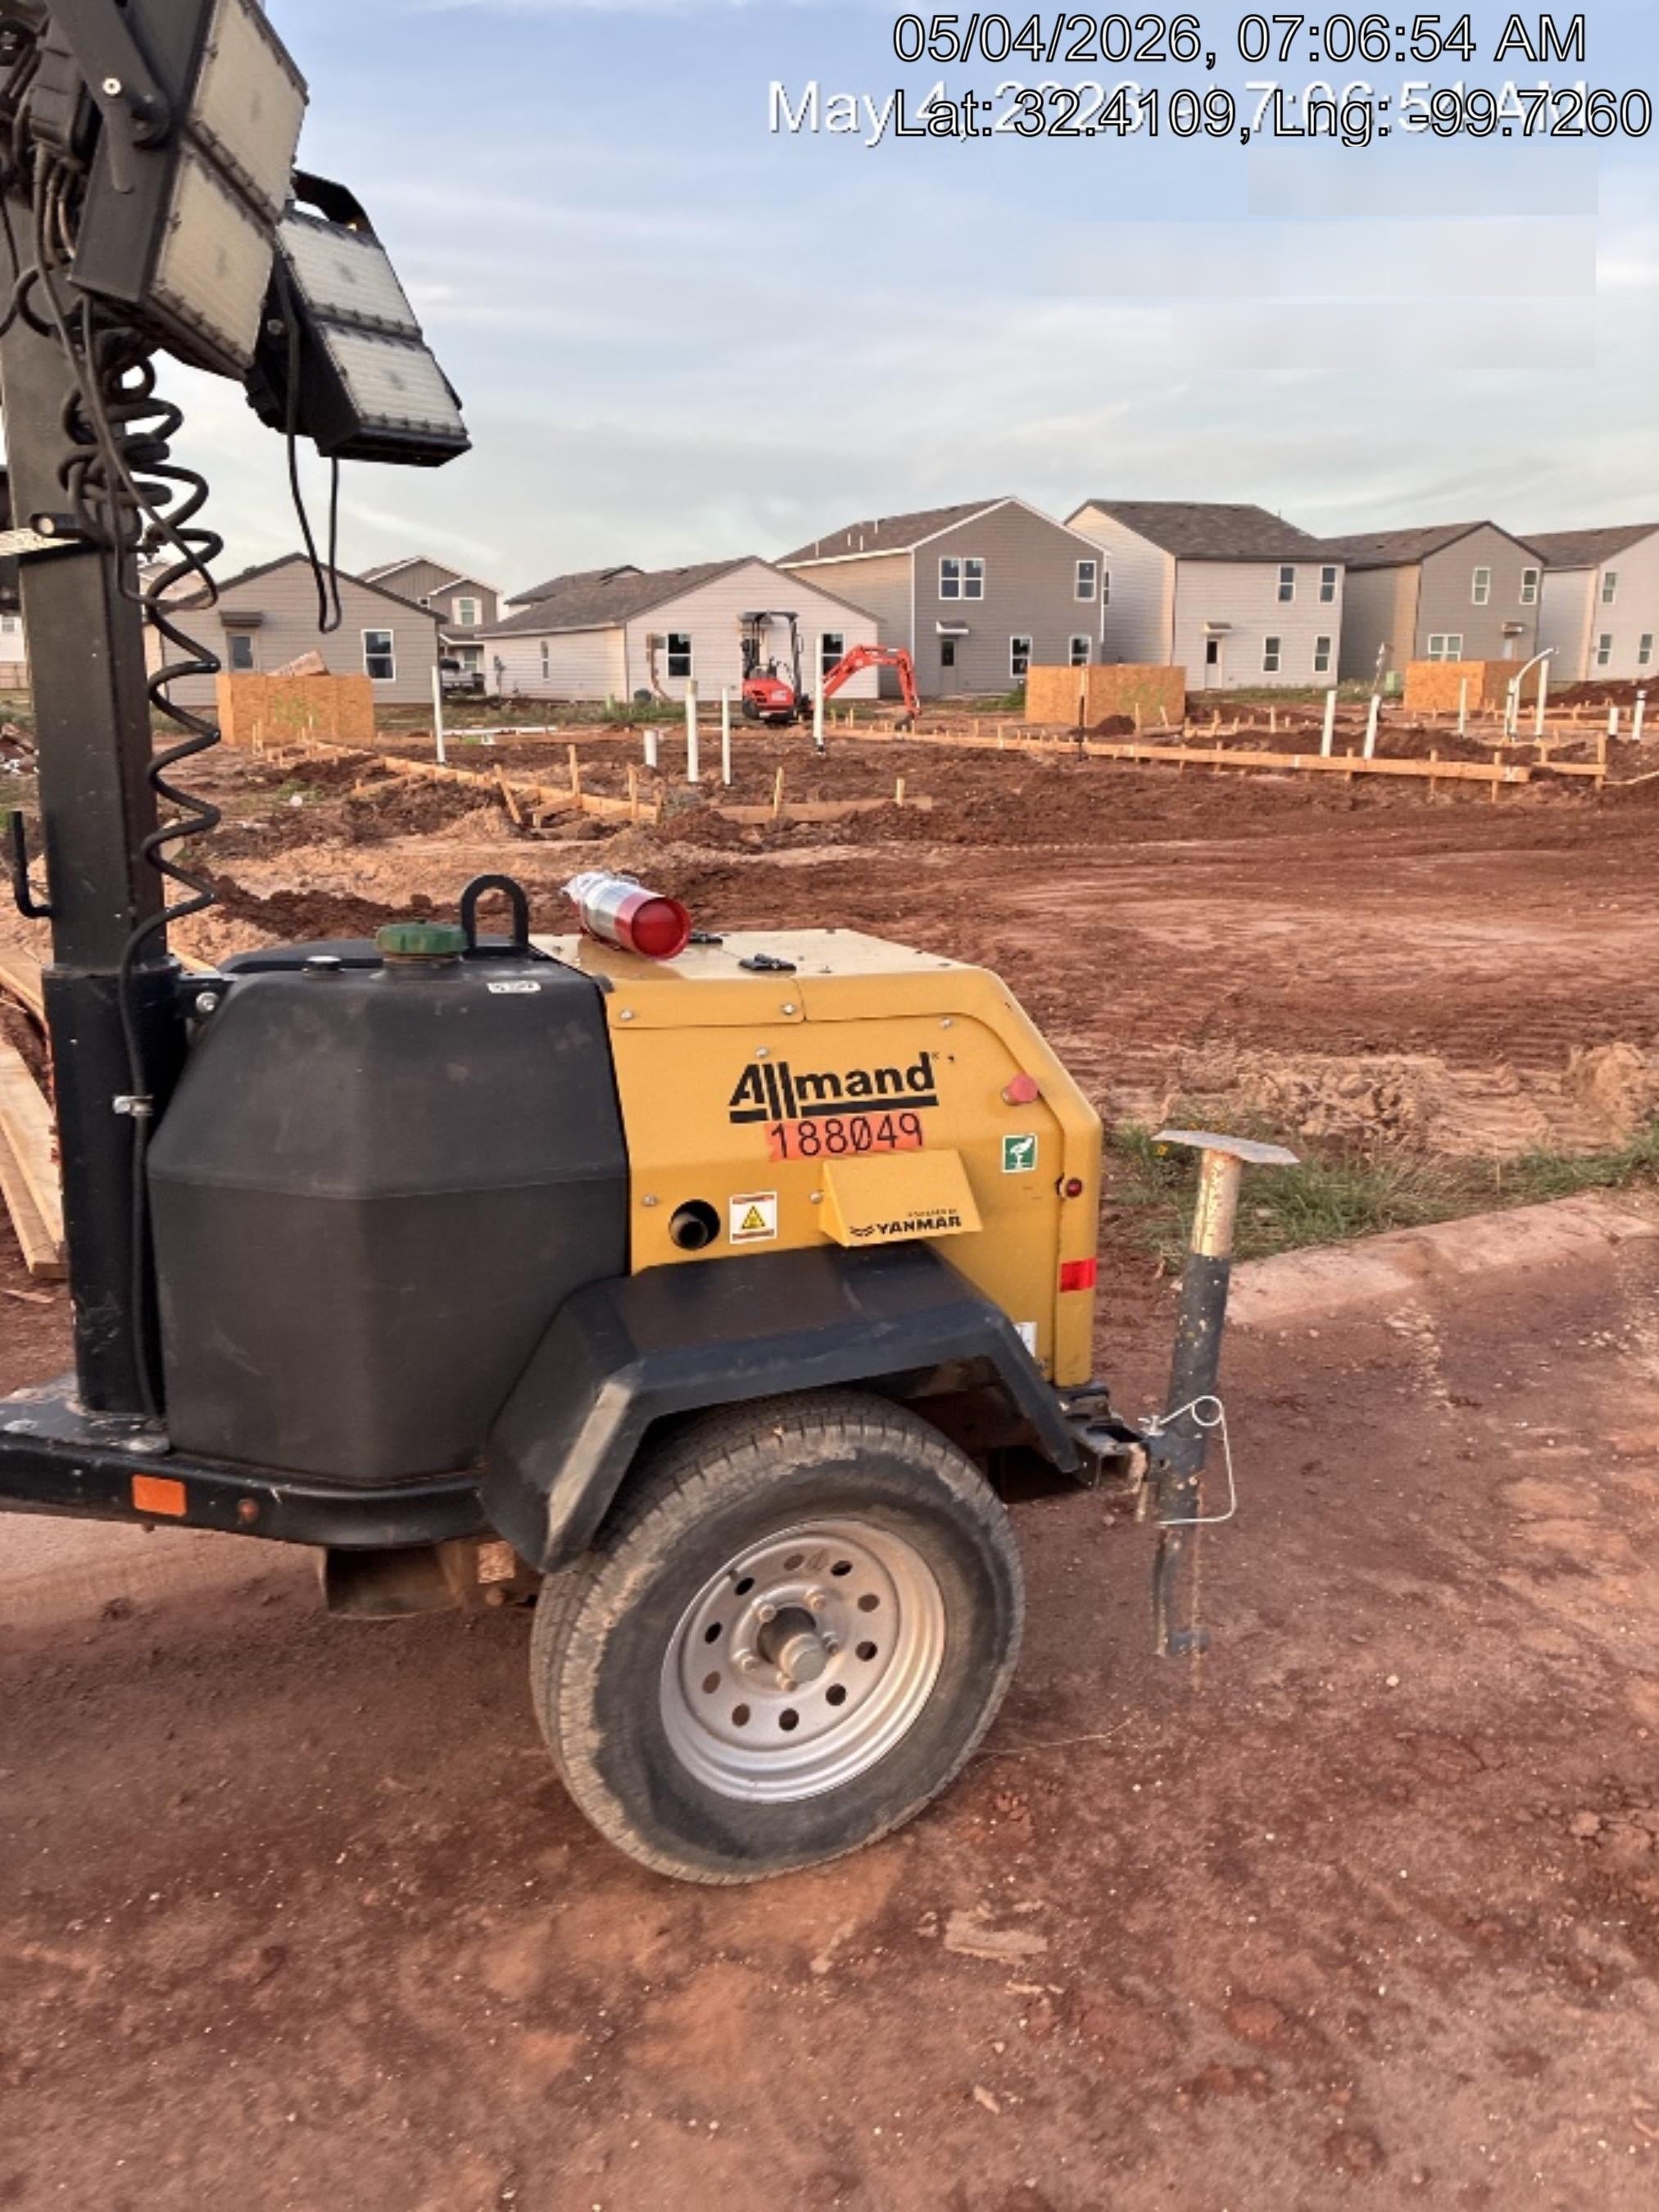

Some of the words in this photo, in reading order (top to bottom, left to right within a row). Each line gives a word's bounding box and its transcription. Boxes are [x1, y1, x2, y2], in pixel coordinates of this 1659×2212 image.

[728, 1051, 935, 1121] Allmand
[771, 1112, 923, 1158] 188049
[876, 1216, 962, 1235] YANMAR
